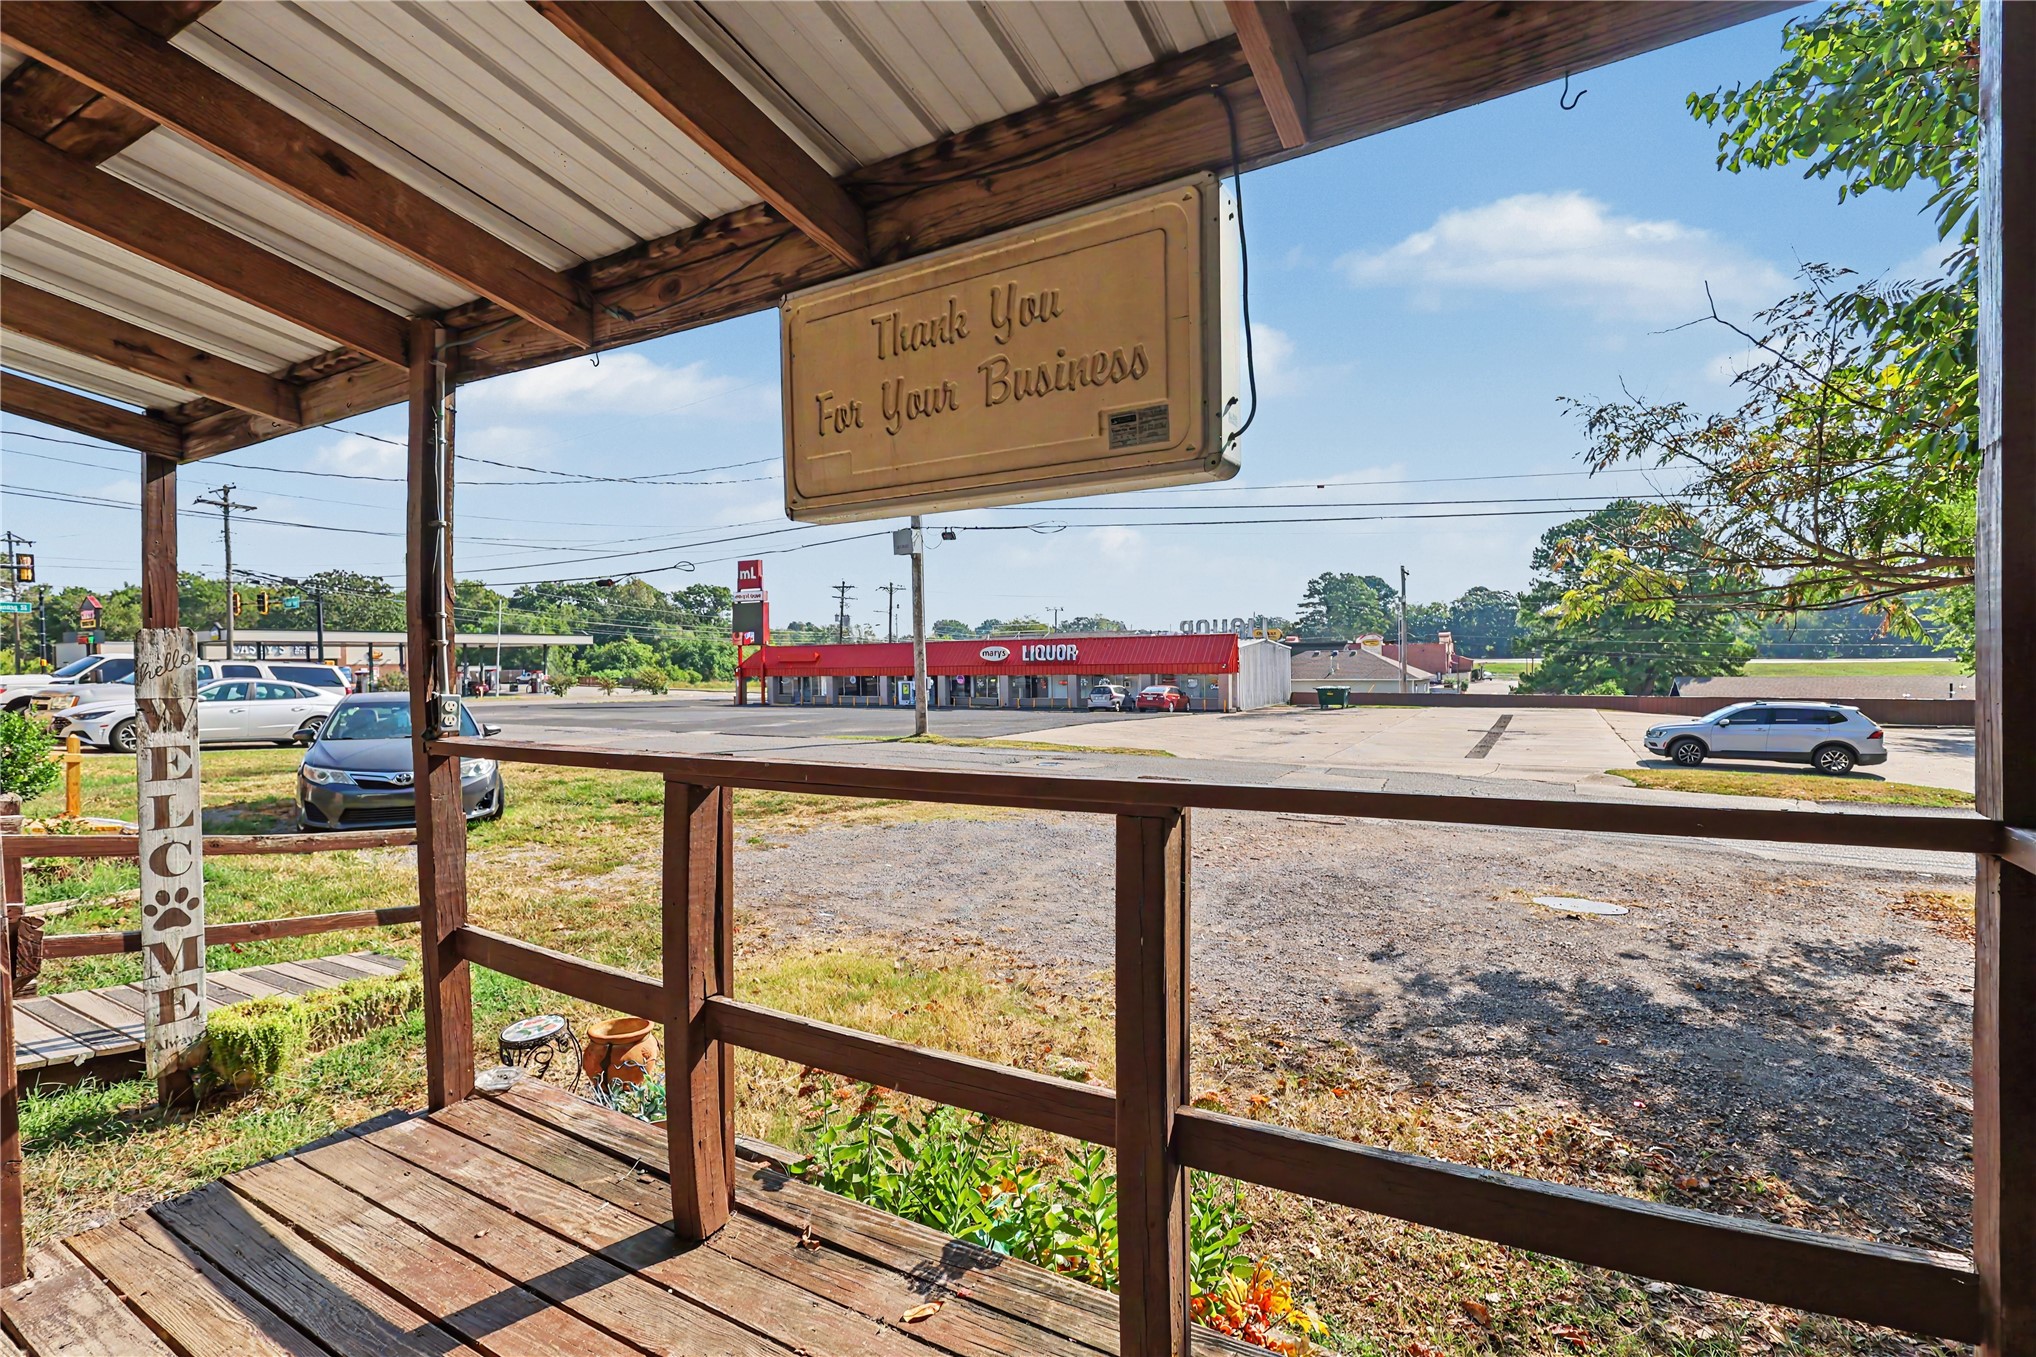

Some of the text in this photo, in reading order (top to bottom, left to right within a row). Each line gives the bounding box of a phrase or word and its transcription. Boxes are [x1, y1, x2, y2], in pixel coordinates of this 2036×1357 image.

[871, 280, 1064, 360] Thank You
[816, 343, 1150, 436] For Your Business
[740, 567, 756, 580] mL
[140, 649, 191, 686] hello
[1022, 644, 1077, 661] LIQUOR
